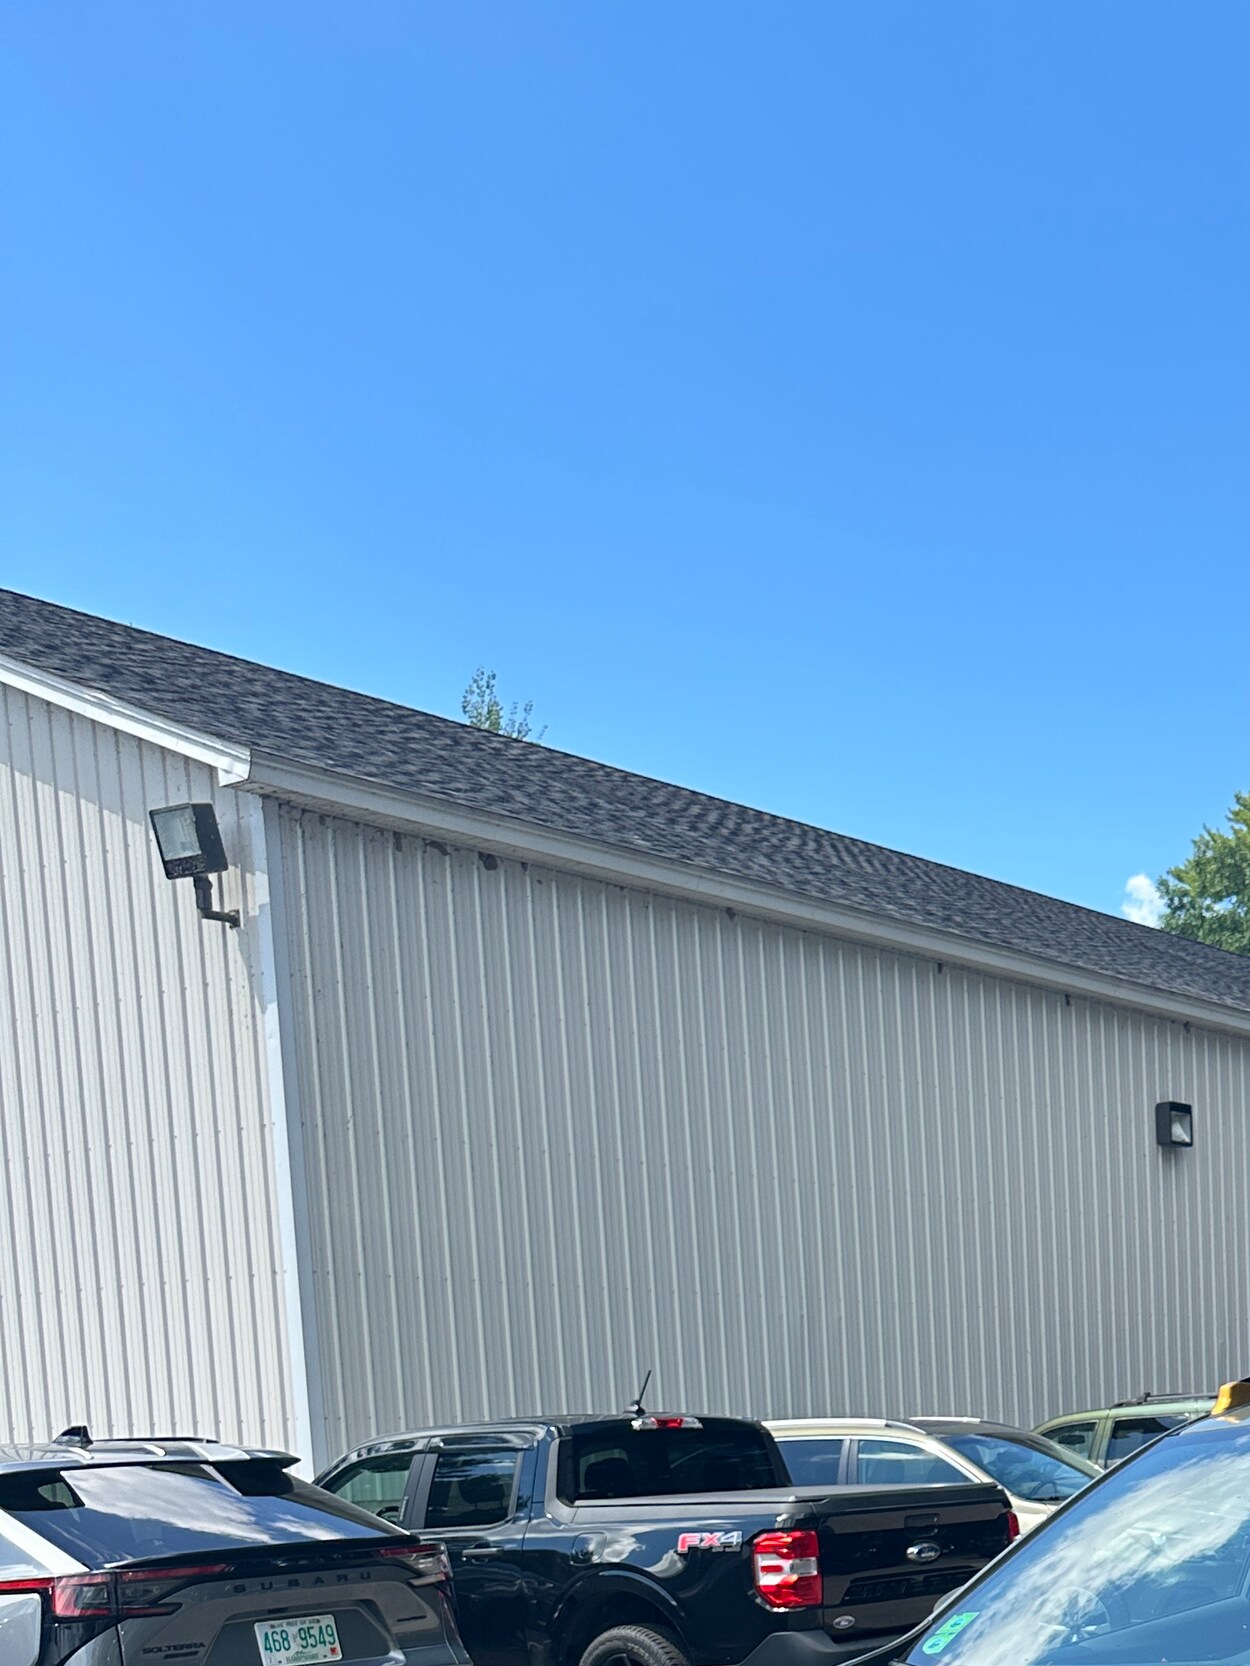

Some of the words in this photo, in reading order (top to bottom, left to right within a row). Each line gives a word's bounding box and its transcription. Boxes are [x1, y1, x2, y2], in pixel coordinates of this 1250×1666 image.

[678, 1531, 743, 1554] FX4
[233, 1571, 372, 1594] SUBARU
[142, 1642, 206, 1655] SOLTERRA
[263, 1629, 291, 1653] 468
[298, 1624, 336, 1649] 9549
